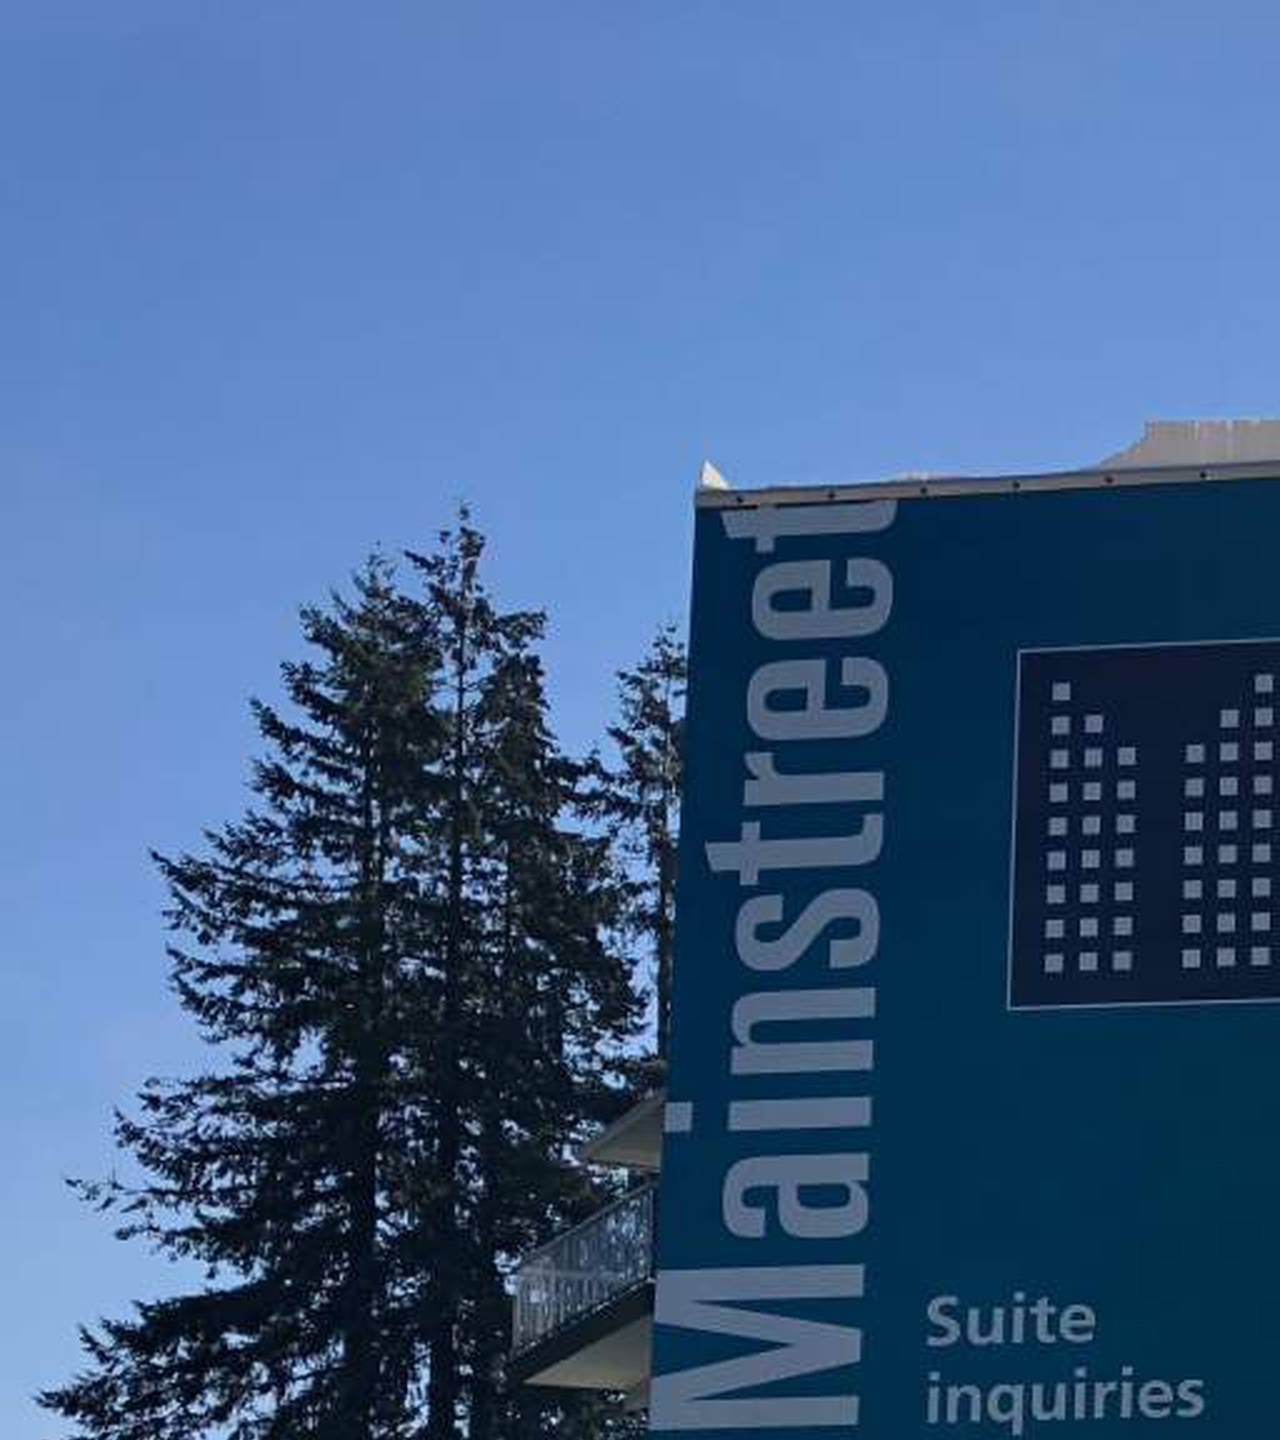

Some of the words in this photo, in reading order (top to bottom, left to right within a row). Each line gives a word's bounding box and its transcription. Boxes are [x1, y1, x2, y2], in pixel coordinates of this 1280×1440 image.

[650, 499, 898, 1431] Mainstreet
[926, 1291, 1096, 1348] Suite
[926, 1366, 1205, 1436] inquiries
